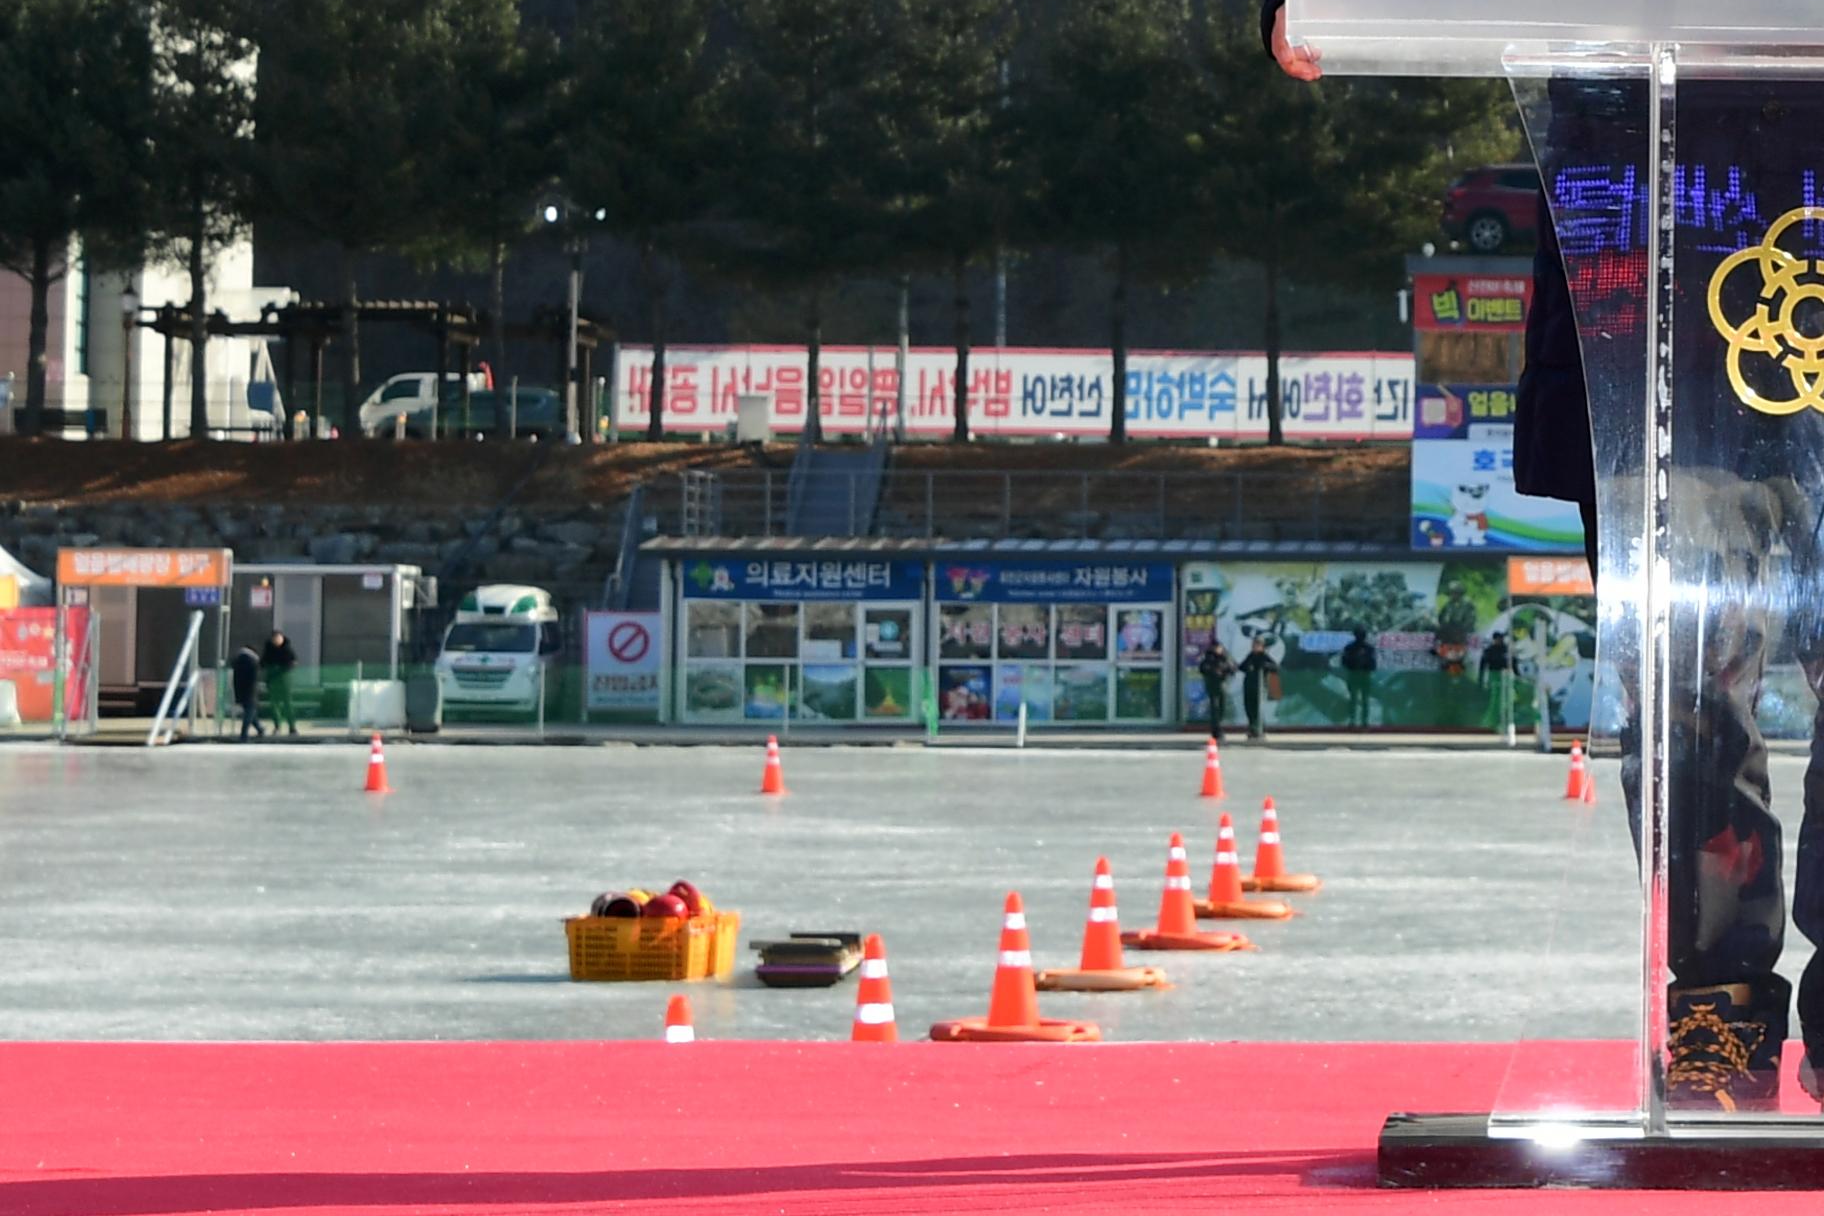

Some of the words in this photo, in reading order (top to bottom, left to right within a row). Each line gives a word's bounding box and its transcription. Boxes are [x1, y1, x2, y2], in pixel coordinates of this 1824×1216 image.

[1466, 298, 1523, 322] 이벤트
[1468, 391, 1516, 417] 얼음
[745, 561, 891, 588] 의료지원센터
[1072, 567, 1148, 587] 자원봉사
